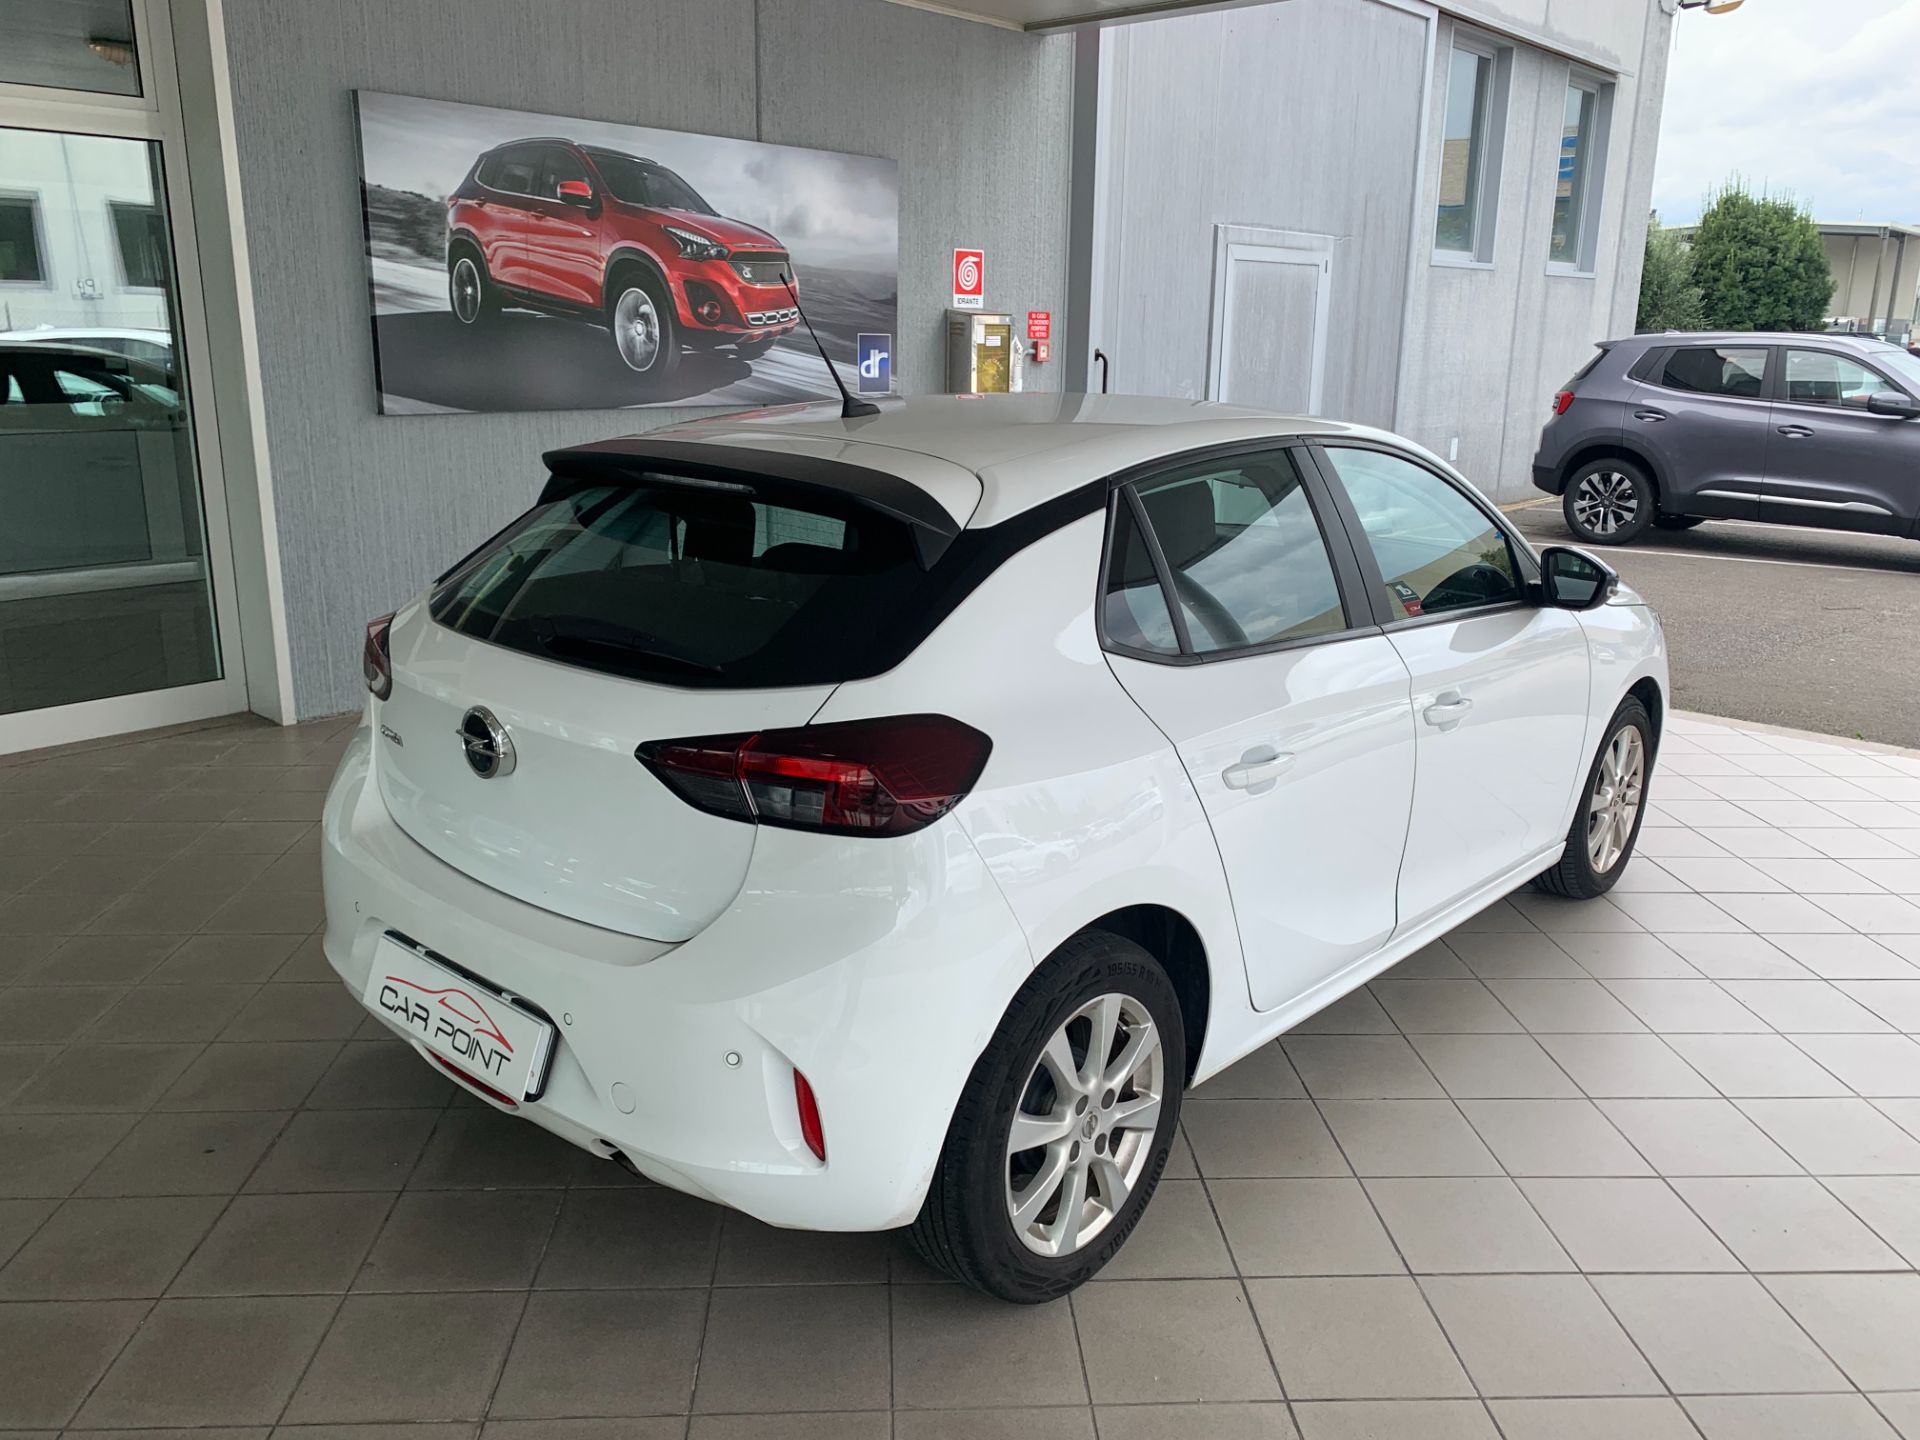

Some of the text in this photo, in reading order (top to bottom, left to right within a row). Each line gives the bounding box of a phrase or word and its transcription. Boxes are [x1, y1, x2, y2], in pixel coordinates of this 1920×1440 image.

[957, 297, 979, 305] IDRANTE
[860, 349, 889, 378] dr
[379, 985, 511, 1076] CAR POINT
